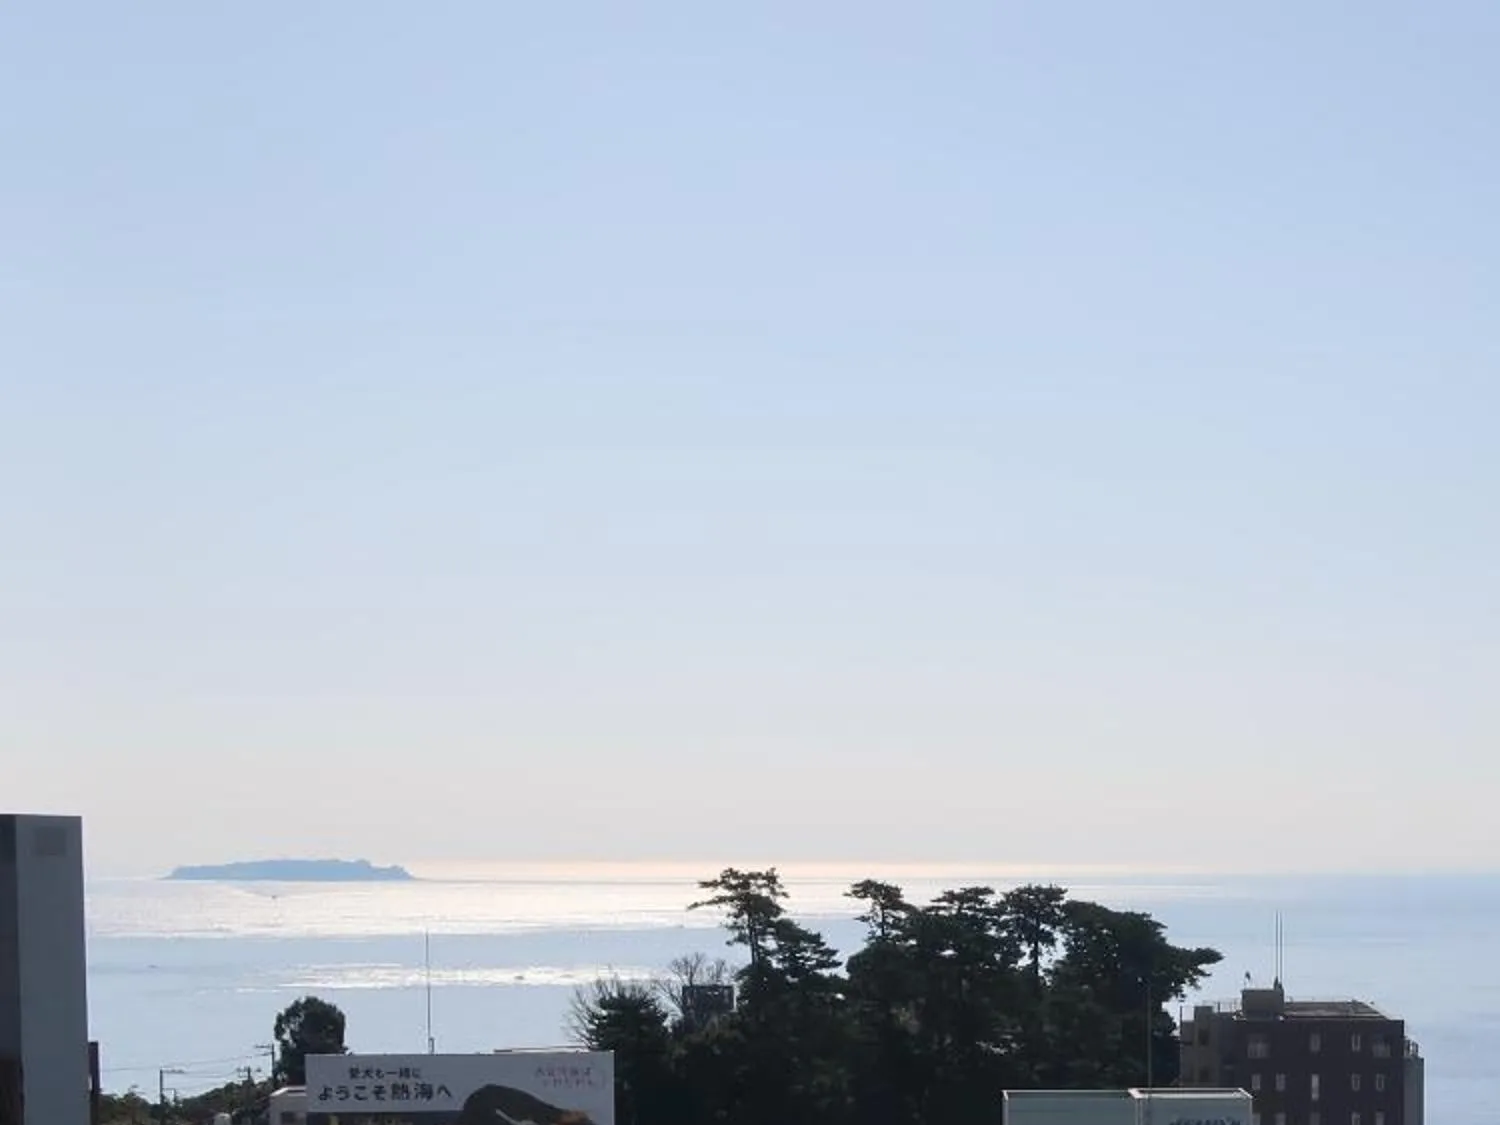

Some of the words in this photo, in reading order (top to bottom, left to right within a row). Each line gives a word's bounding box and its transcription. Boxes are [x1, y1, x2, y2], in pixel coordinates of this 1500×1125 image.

[317, 1083, 453, 1101] ようこそ熱海へ
